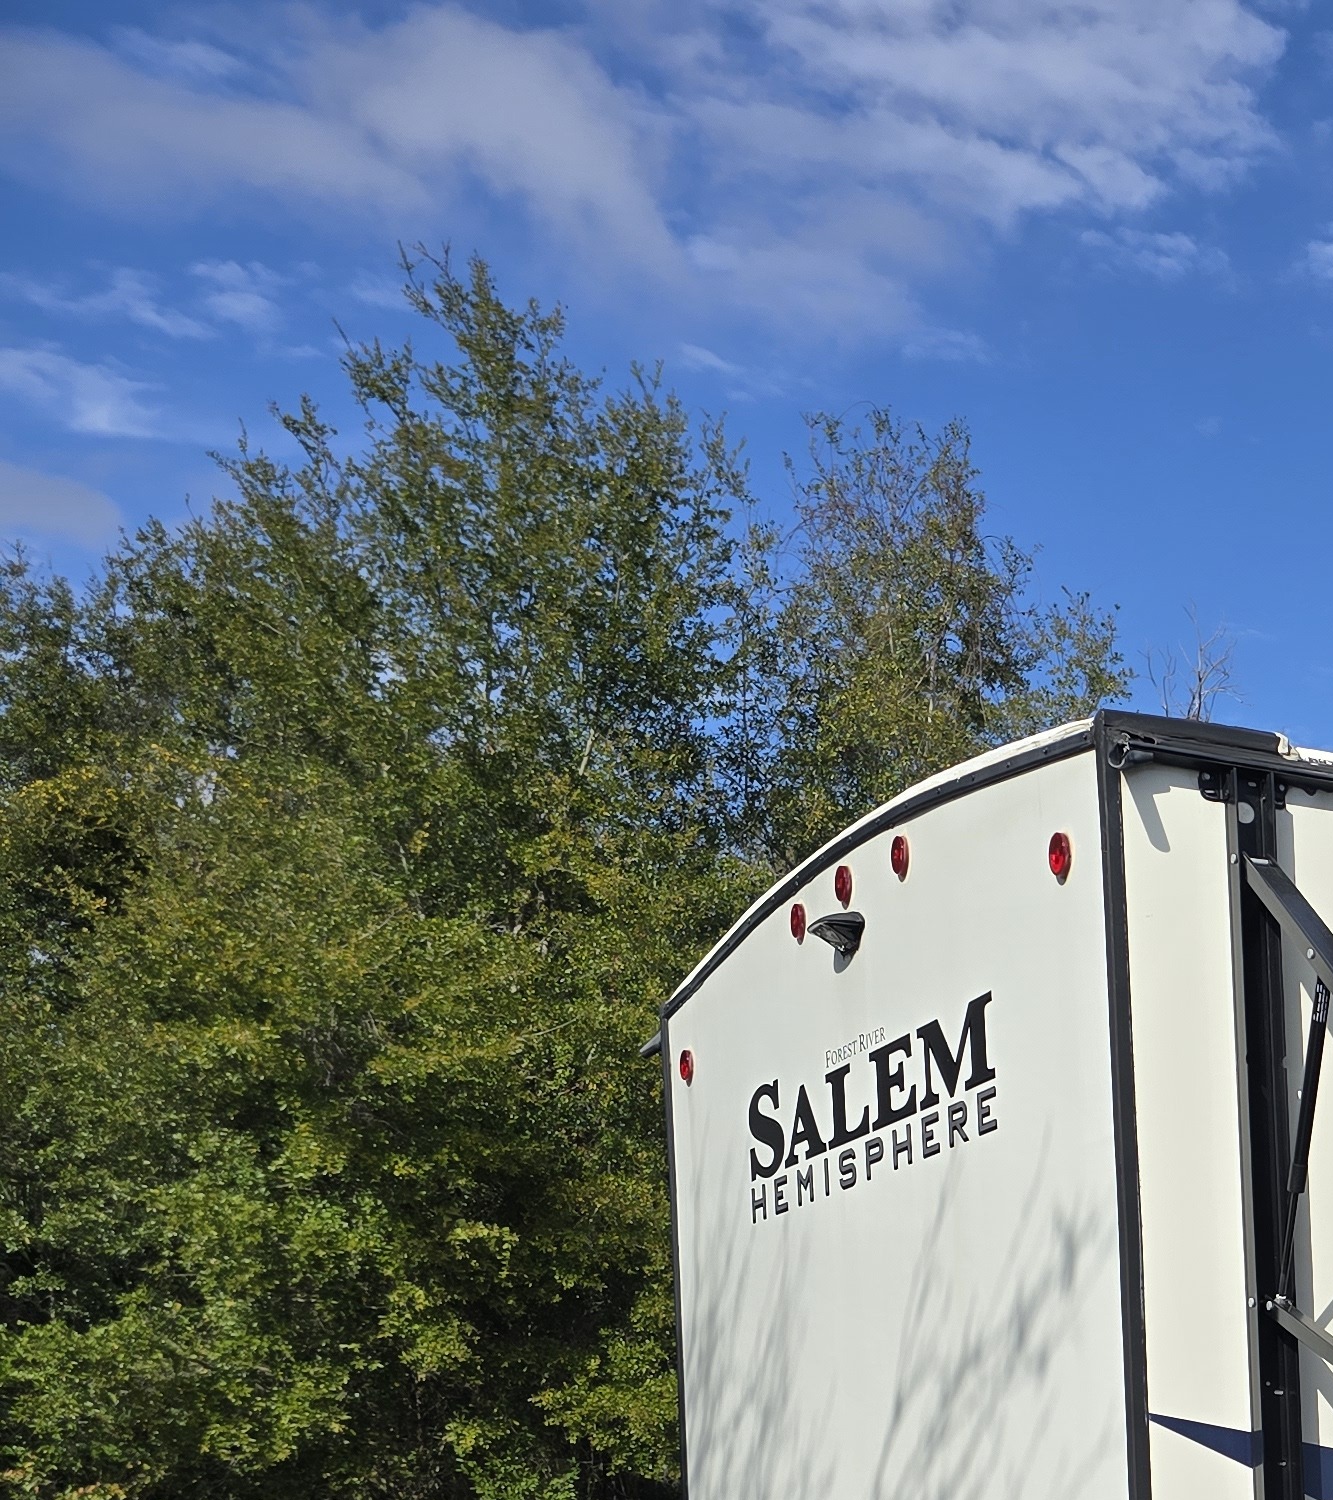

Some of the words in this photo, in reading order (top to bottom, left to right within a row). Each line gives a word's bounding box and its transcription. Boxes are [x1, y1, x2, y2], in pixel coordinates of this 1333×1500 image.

[748, 990, 996, 1182] SALEM
[825, 1039, 858, 1069] FOREST
[858, 1026, 886, 1053] RIVER
[751, 1086, 998, 1224] HEMISPHERE
